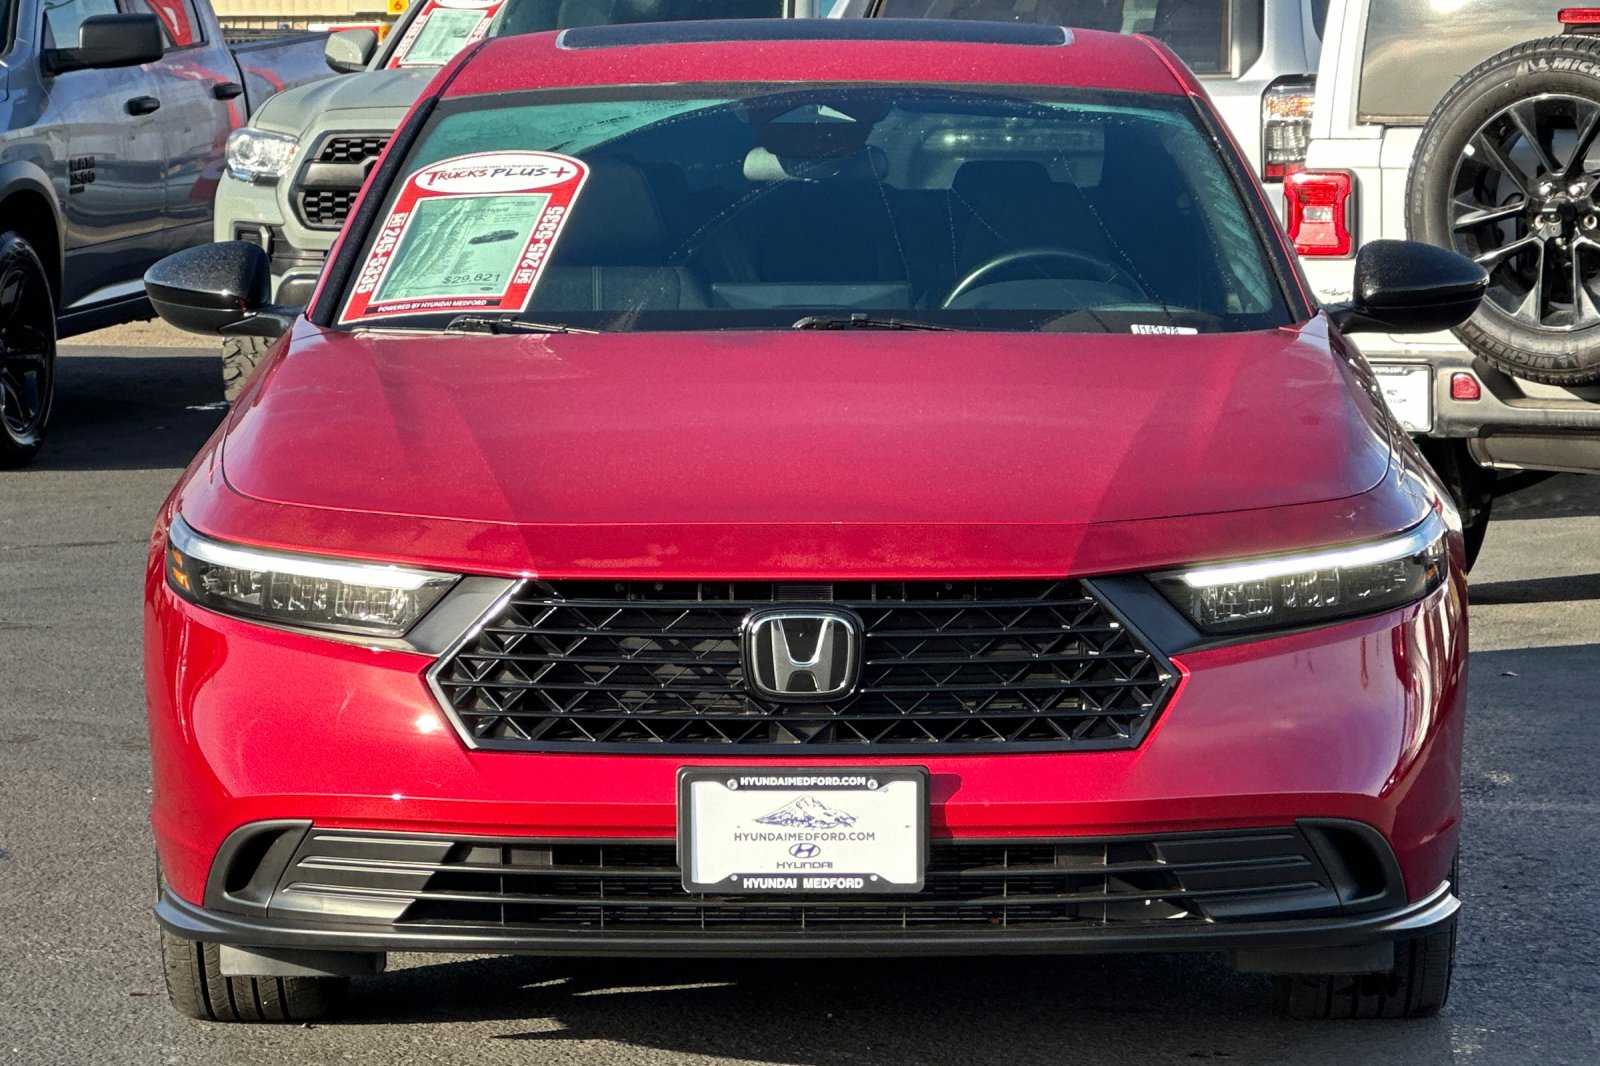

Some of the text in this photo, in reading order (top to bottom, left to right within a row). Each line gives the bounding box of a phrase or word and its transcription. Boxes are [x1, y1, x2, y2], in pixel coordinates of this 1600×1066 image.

[393, 1, 403, 11] 6
[516, 206, 565, 283] 541 245-5335
[356, 212, 408, 294] 541 245-5335
[377, 304, 411, 312] POWERED
[452, 299, 487, 307] MEDFORD
[1464, 325, 1556, 368] MICHELIN
[740, 776, 866, 786] HYUNDAIMEDFORD.COM
[734, 831, 875, 842] HYUNDAIMEDFORD.COM
[776, 861, 833, 869] HYUNDAI
[743, 877, 864, 889] HYUNDAI MEDFORD
